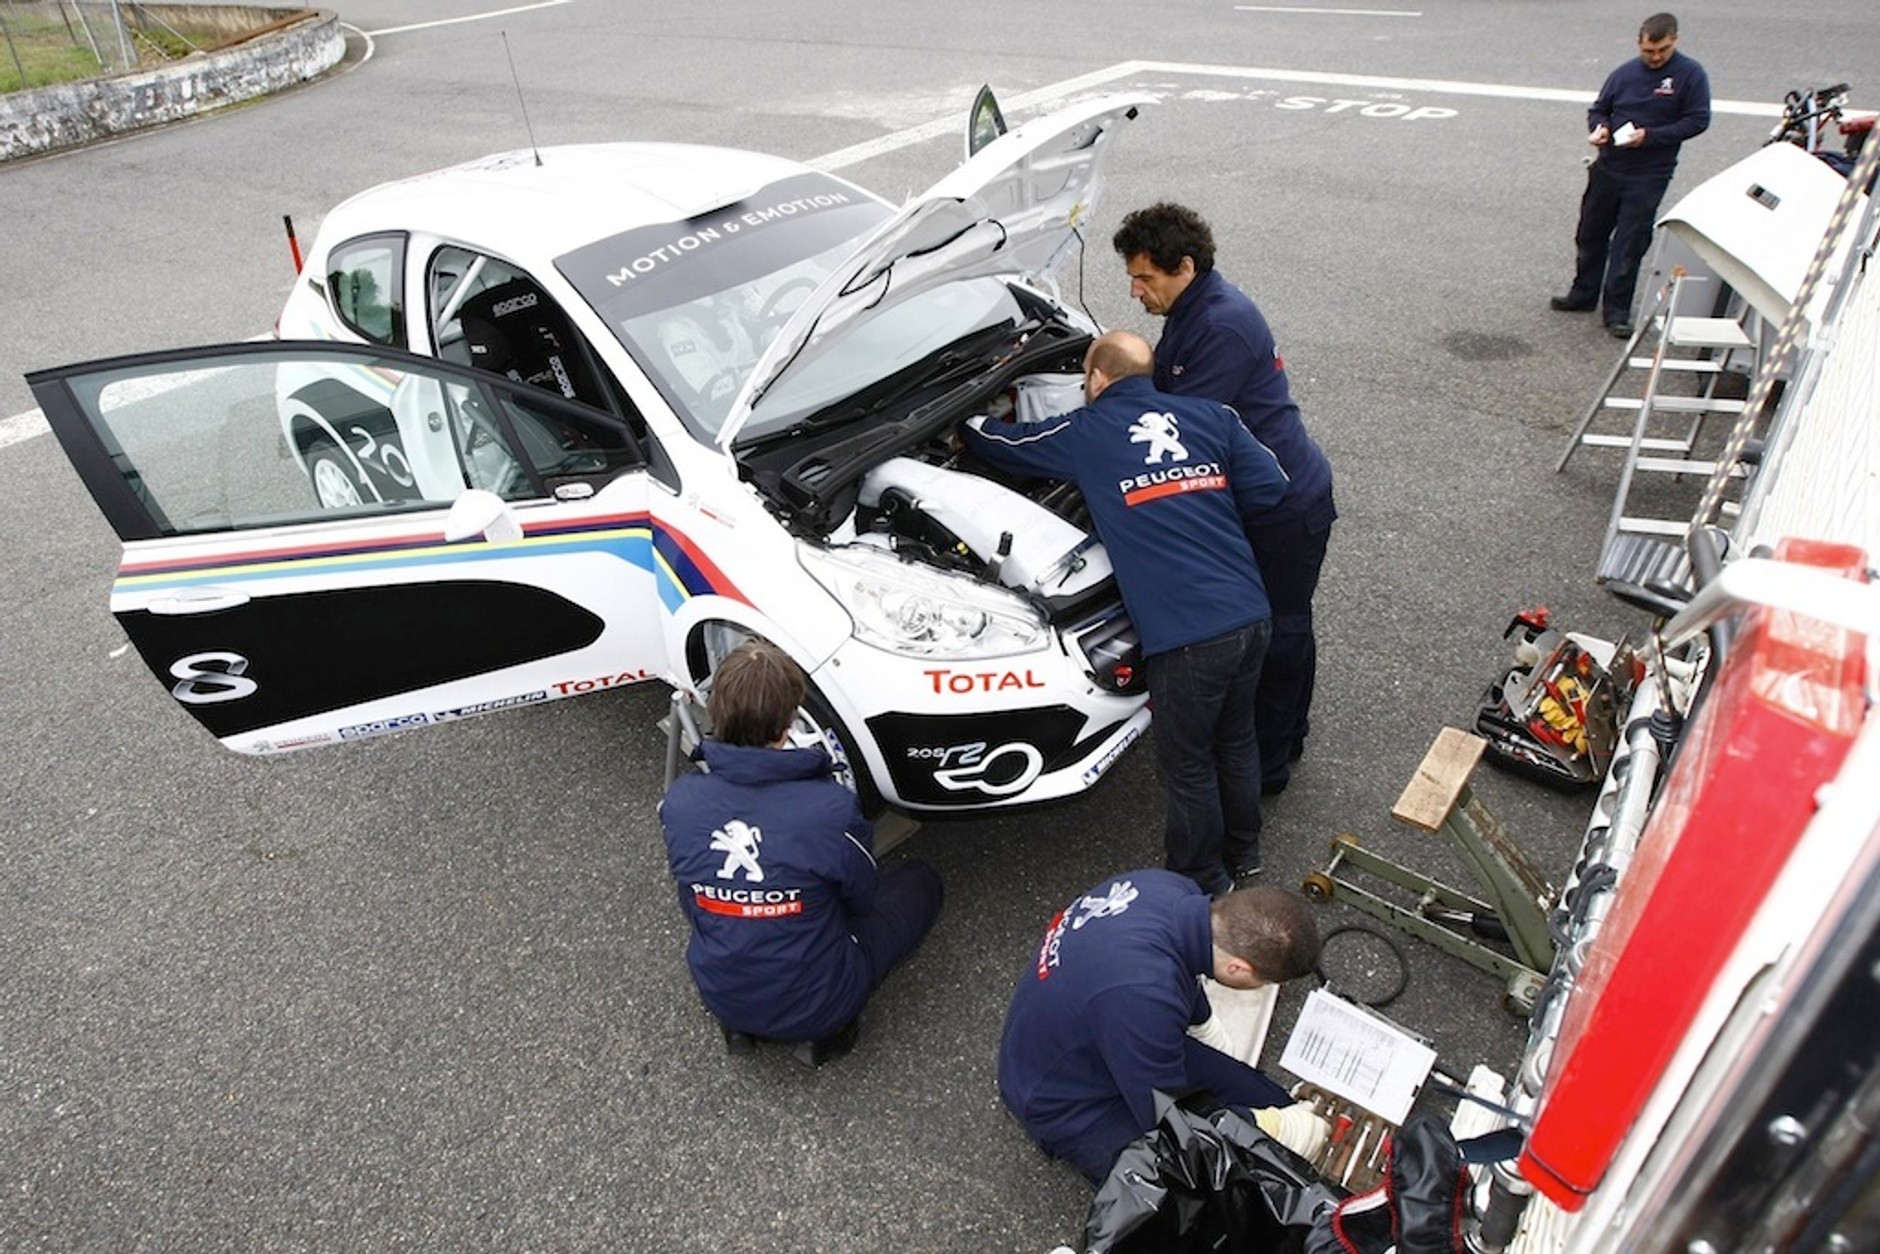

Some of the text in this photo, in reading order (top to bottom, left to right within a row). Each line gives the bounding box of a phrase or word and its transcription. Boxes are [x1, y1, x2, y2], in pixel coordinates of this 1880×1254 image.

[1274, 96, 1459, 120] STOP
[606, 192, 849, 287] MOTION & EMOTION
[1120, 463, 1221, 493] PEUGEOT
[1180, 476, 1224, 490] SPORT
[552, 669, 656, 695] TOTAL
[924, 670, 1045, 694] TOTAL
[461, 691, 544, 716] MICHELIN
[340, 715, 427, 739] sparco
[691, 883, 801, 903] PEUGEOT
[742, 902, 797, 916] SPORT
